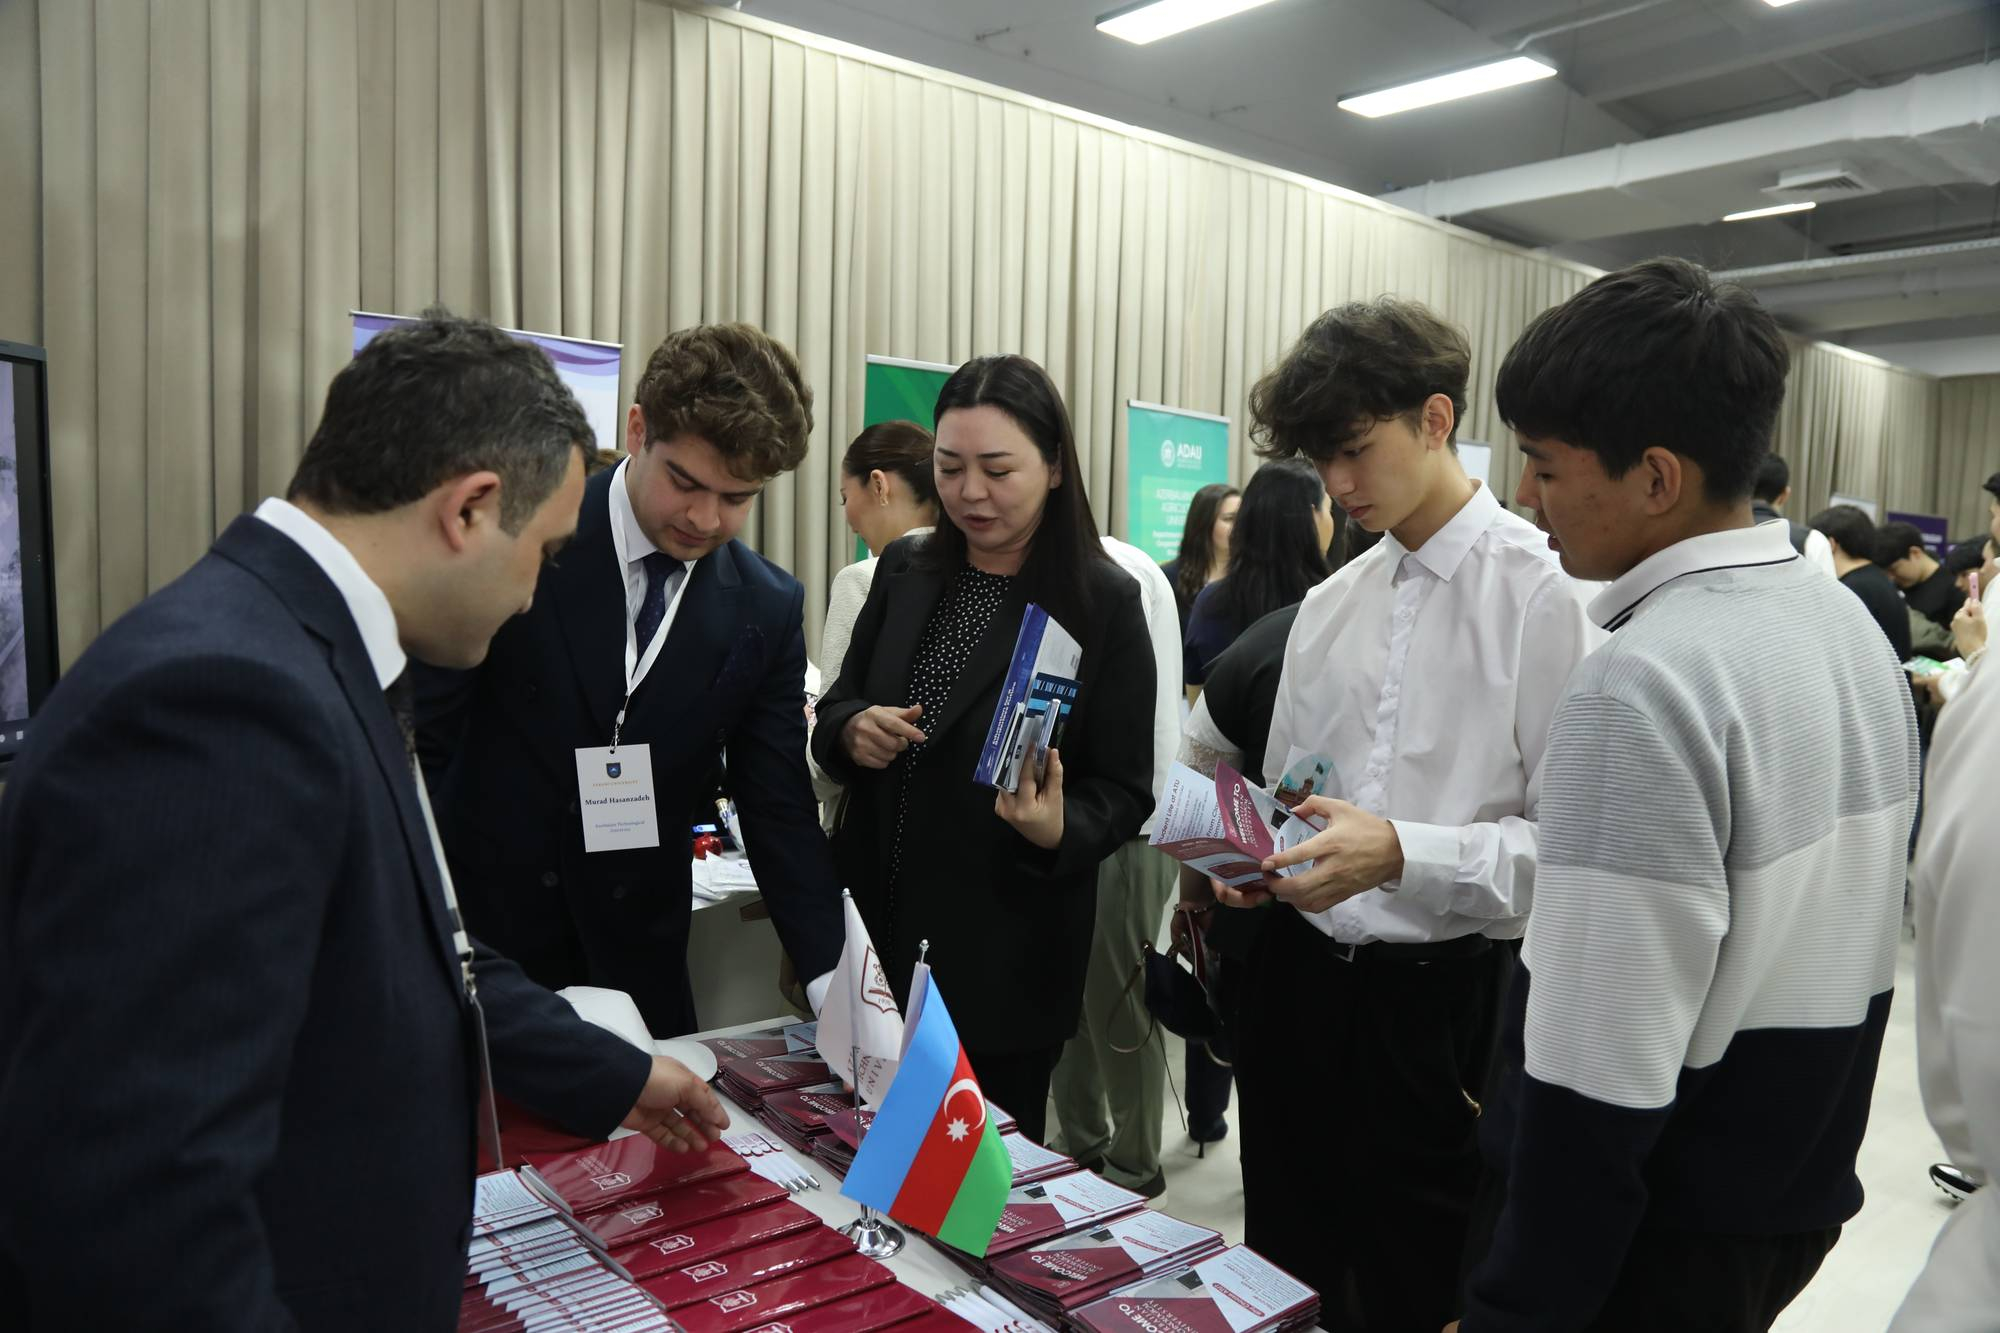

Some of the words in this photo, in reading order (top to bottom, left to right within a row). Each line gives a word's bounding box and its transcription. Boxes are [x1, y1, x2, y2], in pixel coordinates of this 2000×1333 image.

[1176, 443, 1203, 460] ADAU
[1233, 783, 1241, 798] TO
[585, 798, 608, 806] Murad
[609, 795, 650, 804] Hasanzadeh
[1031, 1255, 1047, 1264] TO
[1042, 1262, 1088, 1281] WELCOME
[1118, 1303, 1135, 1317] TO
